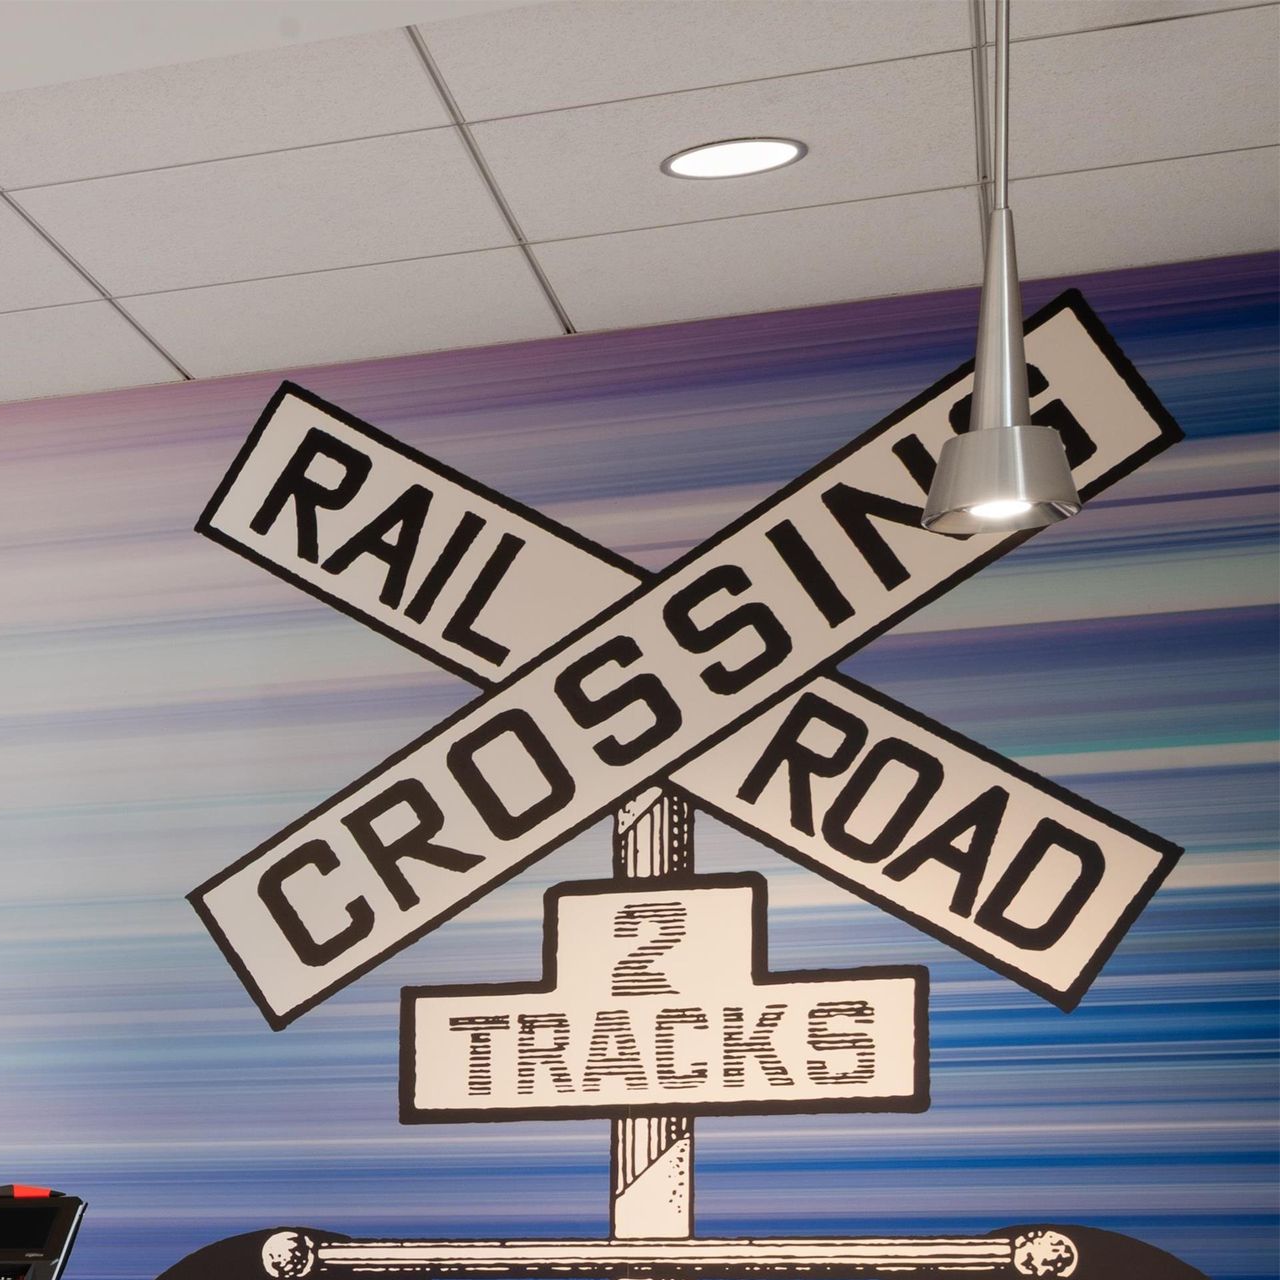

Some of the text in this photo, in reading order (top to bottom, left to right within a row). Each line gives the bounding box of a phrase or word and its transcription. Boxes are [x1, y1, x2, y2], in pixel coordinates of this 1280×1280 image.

[252, 426, 527, 668] RAIL
[734, 691, 1107, 952] ROAD
[611, 900, 687, 998] 2
[447, 1000, 877, 1097] TRACKS
